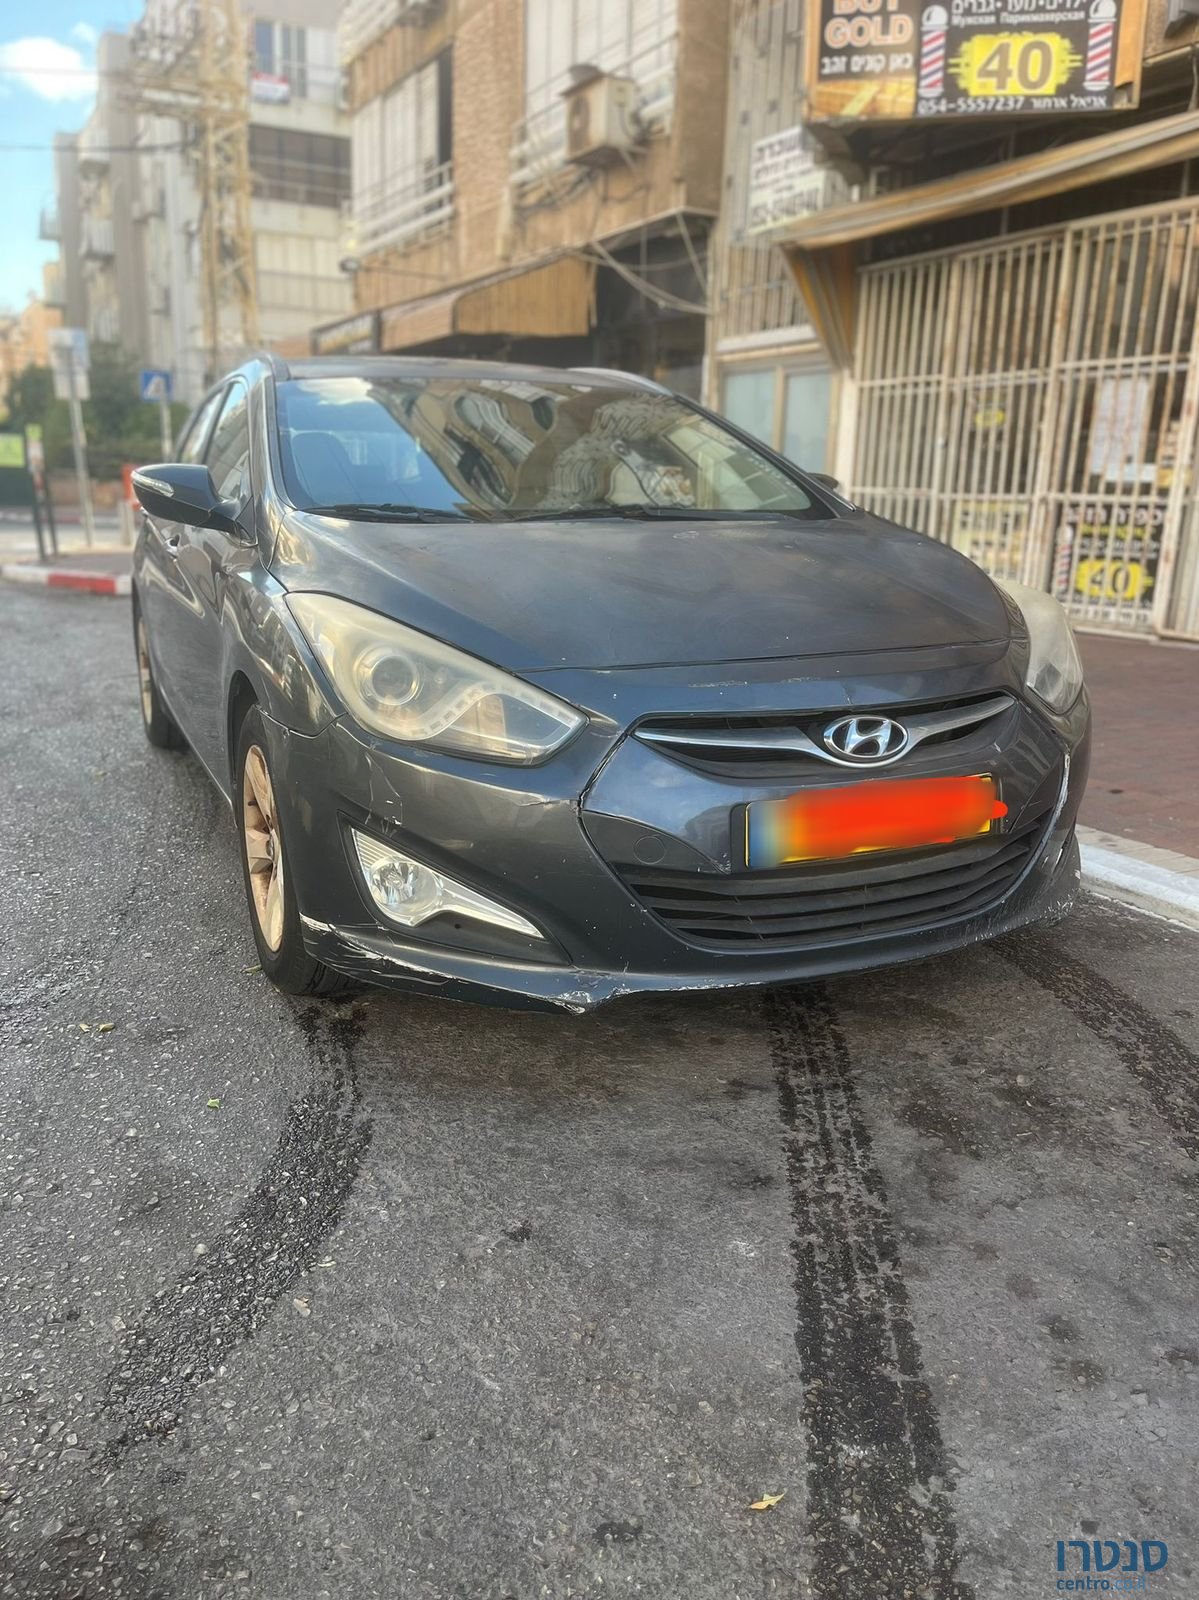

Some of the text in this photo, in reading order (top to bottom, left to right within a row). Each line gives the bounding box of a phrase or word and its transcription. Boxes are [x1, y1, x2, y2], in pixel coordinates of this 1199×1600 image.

[824, 14, 914, 49] GOLD
[976, 39, 1054, 92] 40
[1089, 566, 1131, 596] 40
